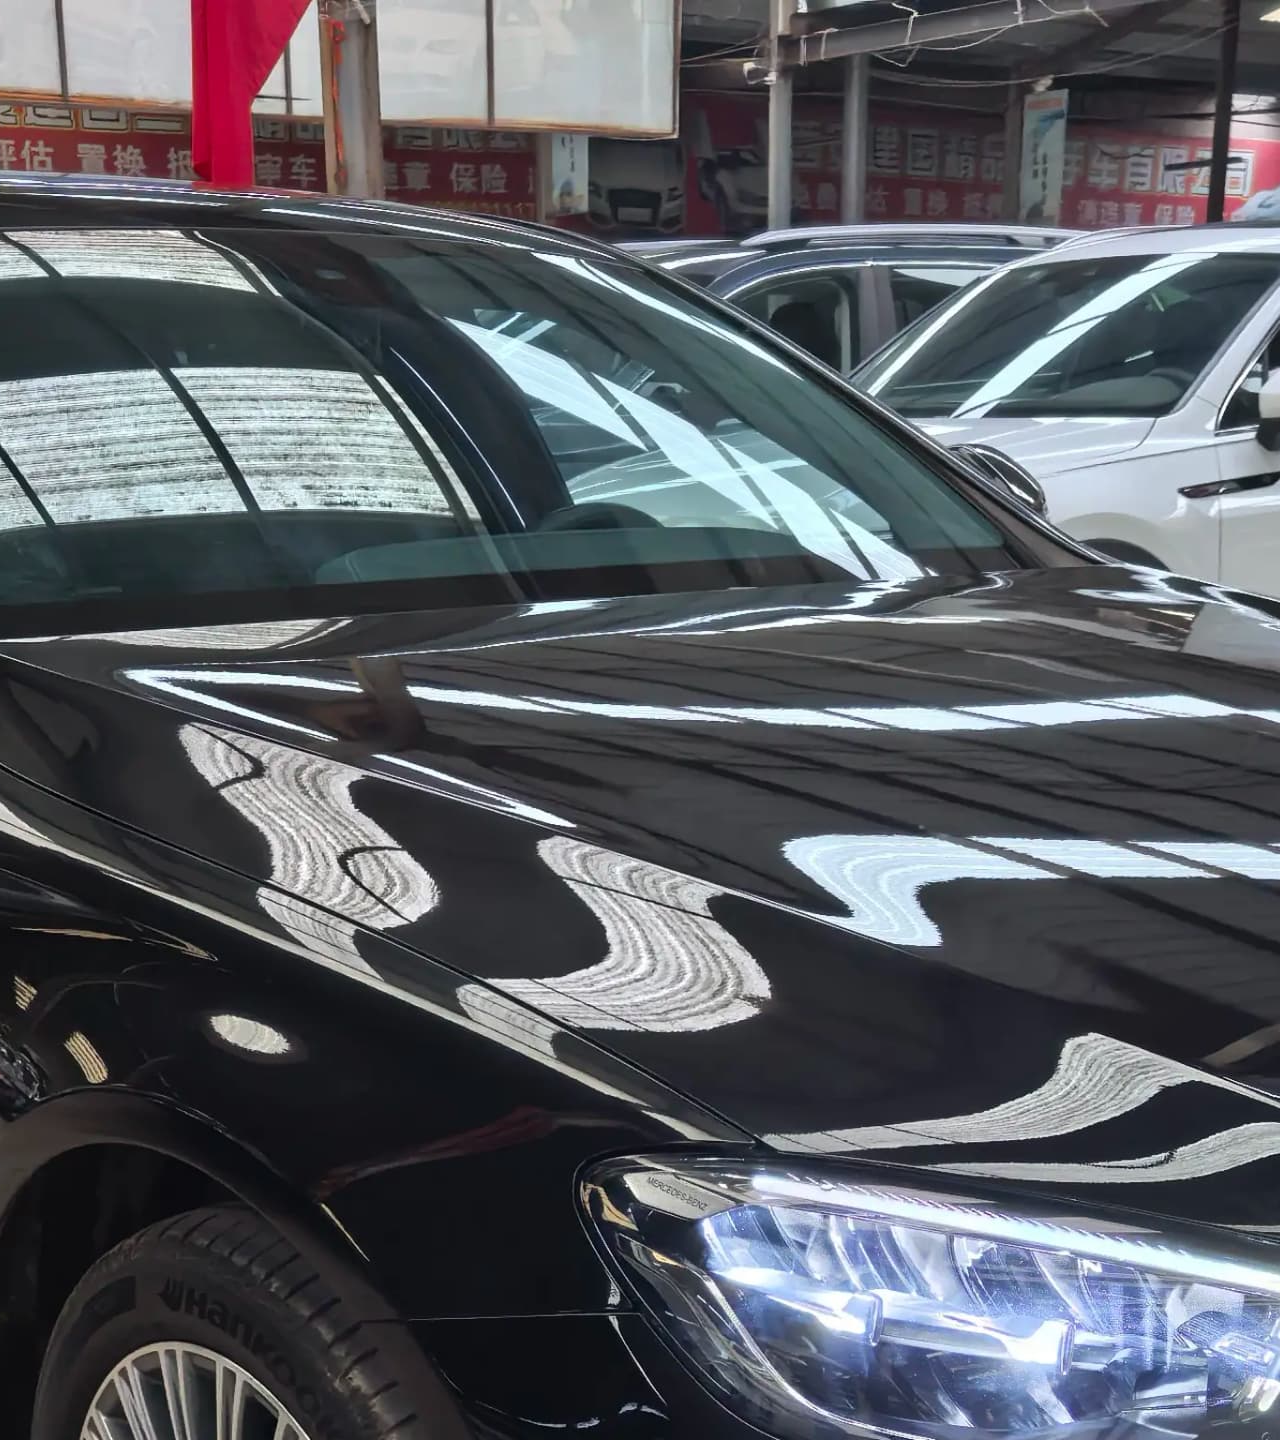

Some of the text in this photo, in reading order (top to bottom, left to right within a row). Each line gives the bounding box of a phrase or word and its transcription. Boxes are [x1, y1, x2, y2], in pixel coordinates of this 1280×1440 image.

[77, 143, 146, 176] 置换
[449, 162, 507, 193] 保险
[648, 1176, 708, 1211] MERCEDES-BENZ
